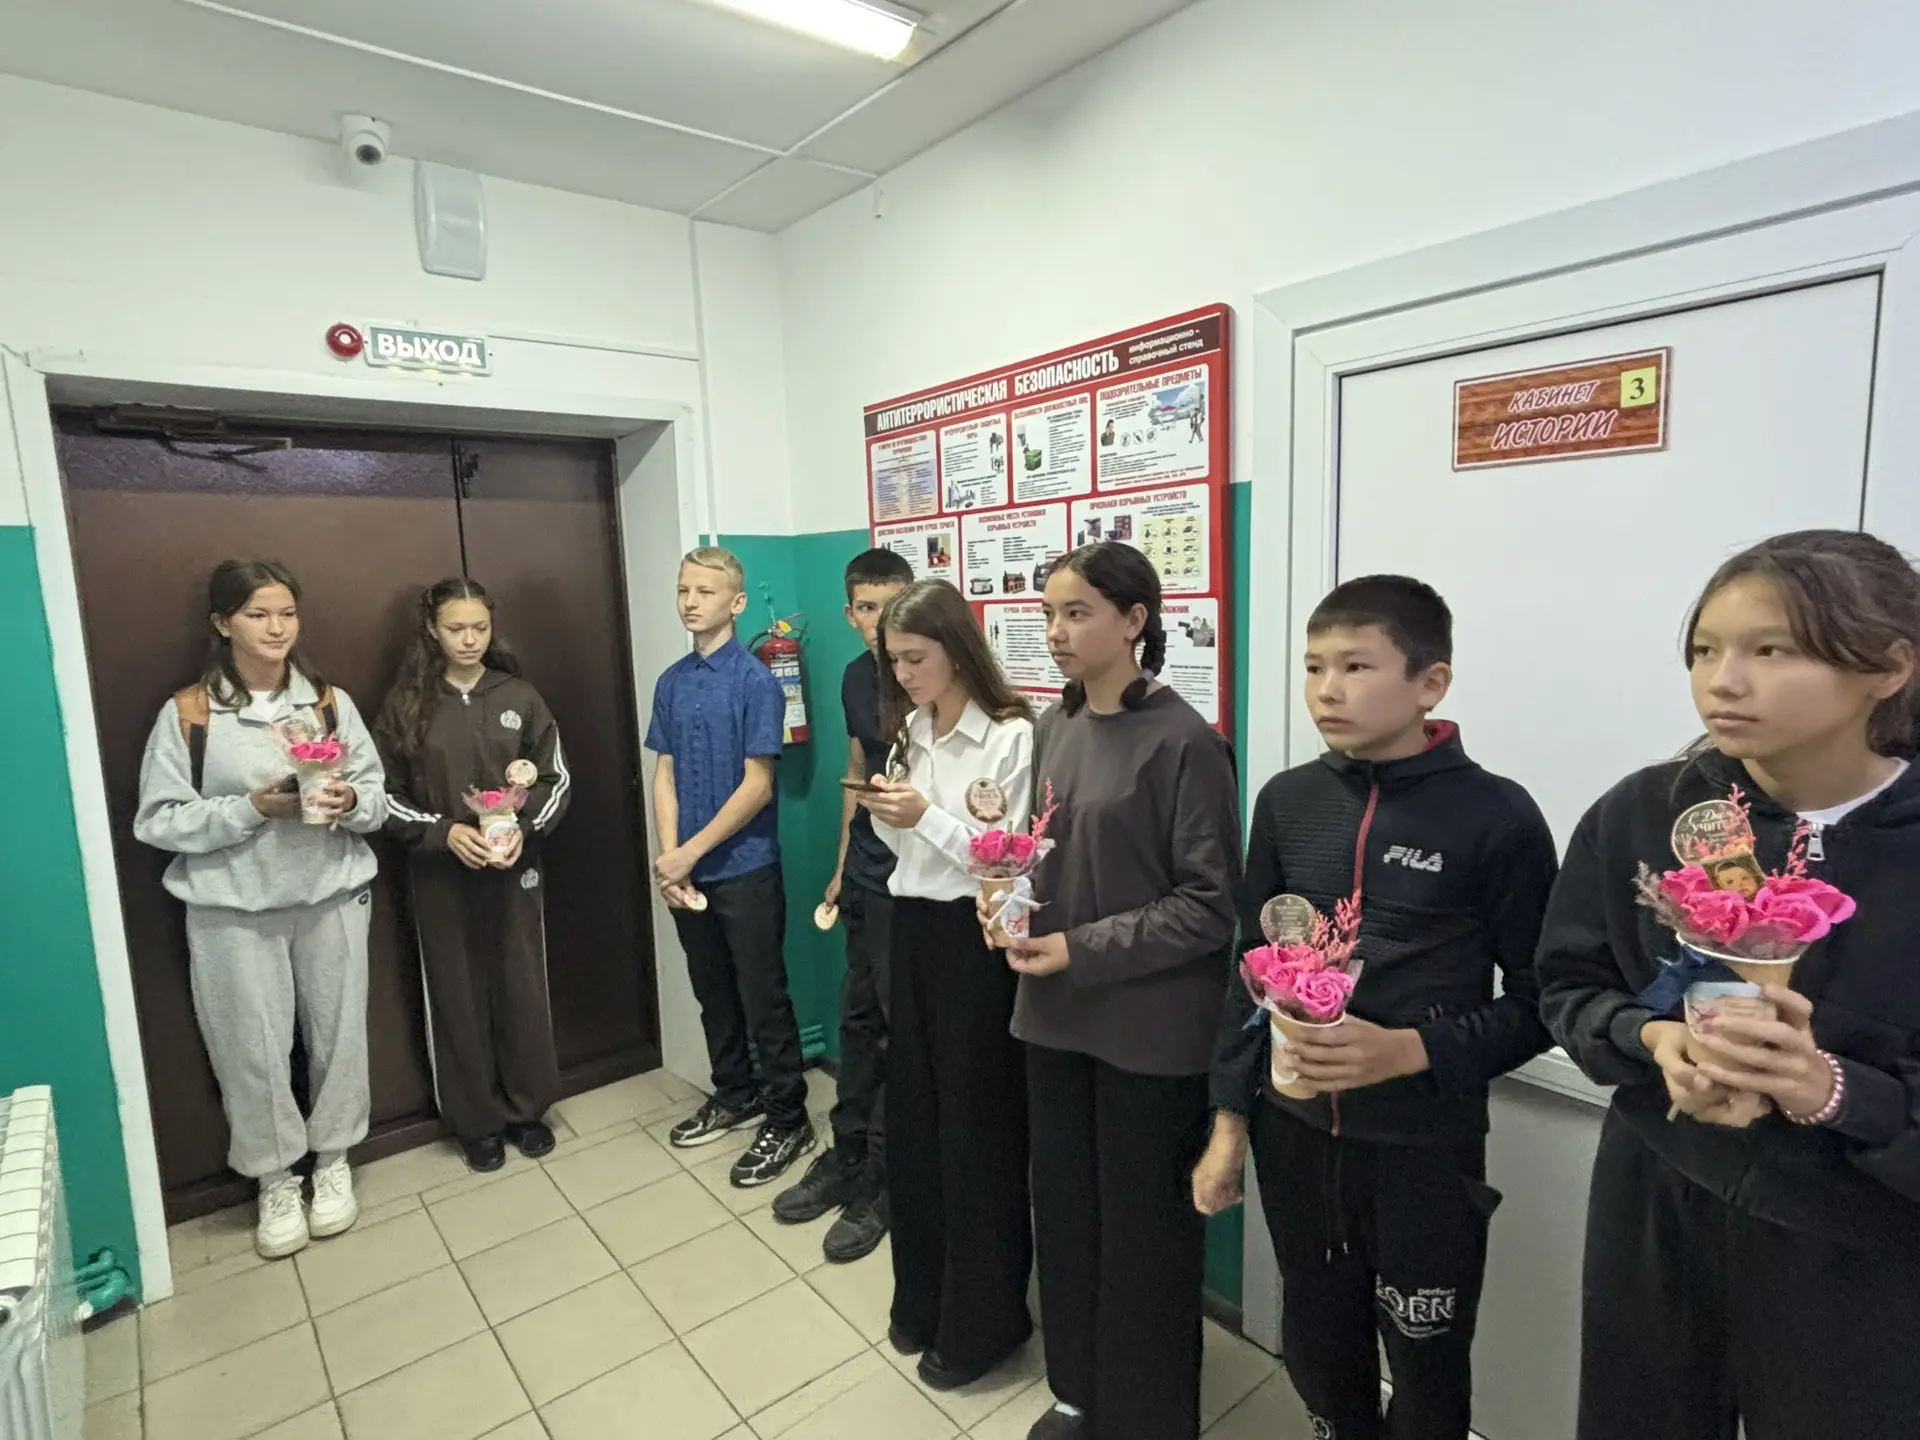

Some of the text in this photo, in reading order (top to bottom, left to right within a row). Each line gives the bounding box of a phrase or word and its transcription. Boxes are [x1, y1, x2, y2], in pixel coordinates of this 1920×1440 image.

[377, 333, 481, 365] ВЫХОД
[1129, 329, 1194, 353] информационно
[1129, 339, 1204, 365] справочный стенд
[877, 350, 1119, 431] АНТИТЕРРОРИСТИЧЕСКАЯ БЕЗОПАСНОСТЬ
[1162, 368, 1202, 387] ПРЕДМЕТЫ
[1508, 377, 1645, 413] КАБИНЕТ 3
[1491, 409, 1617, 450] ИСТОРИИ
[1383, 845, 1443, 872] FILA
